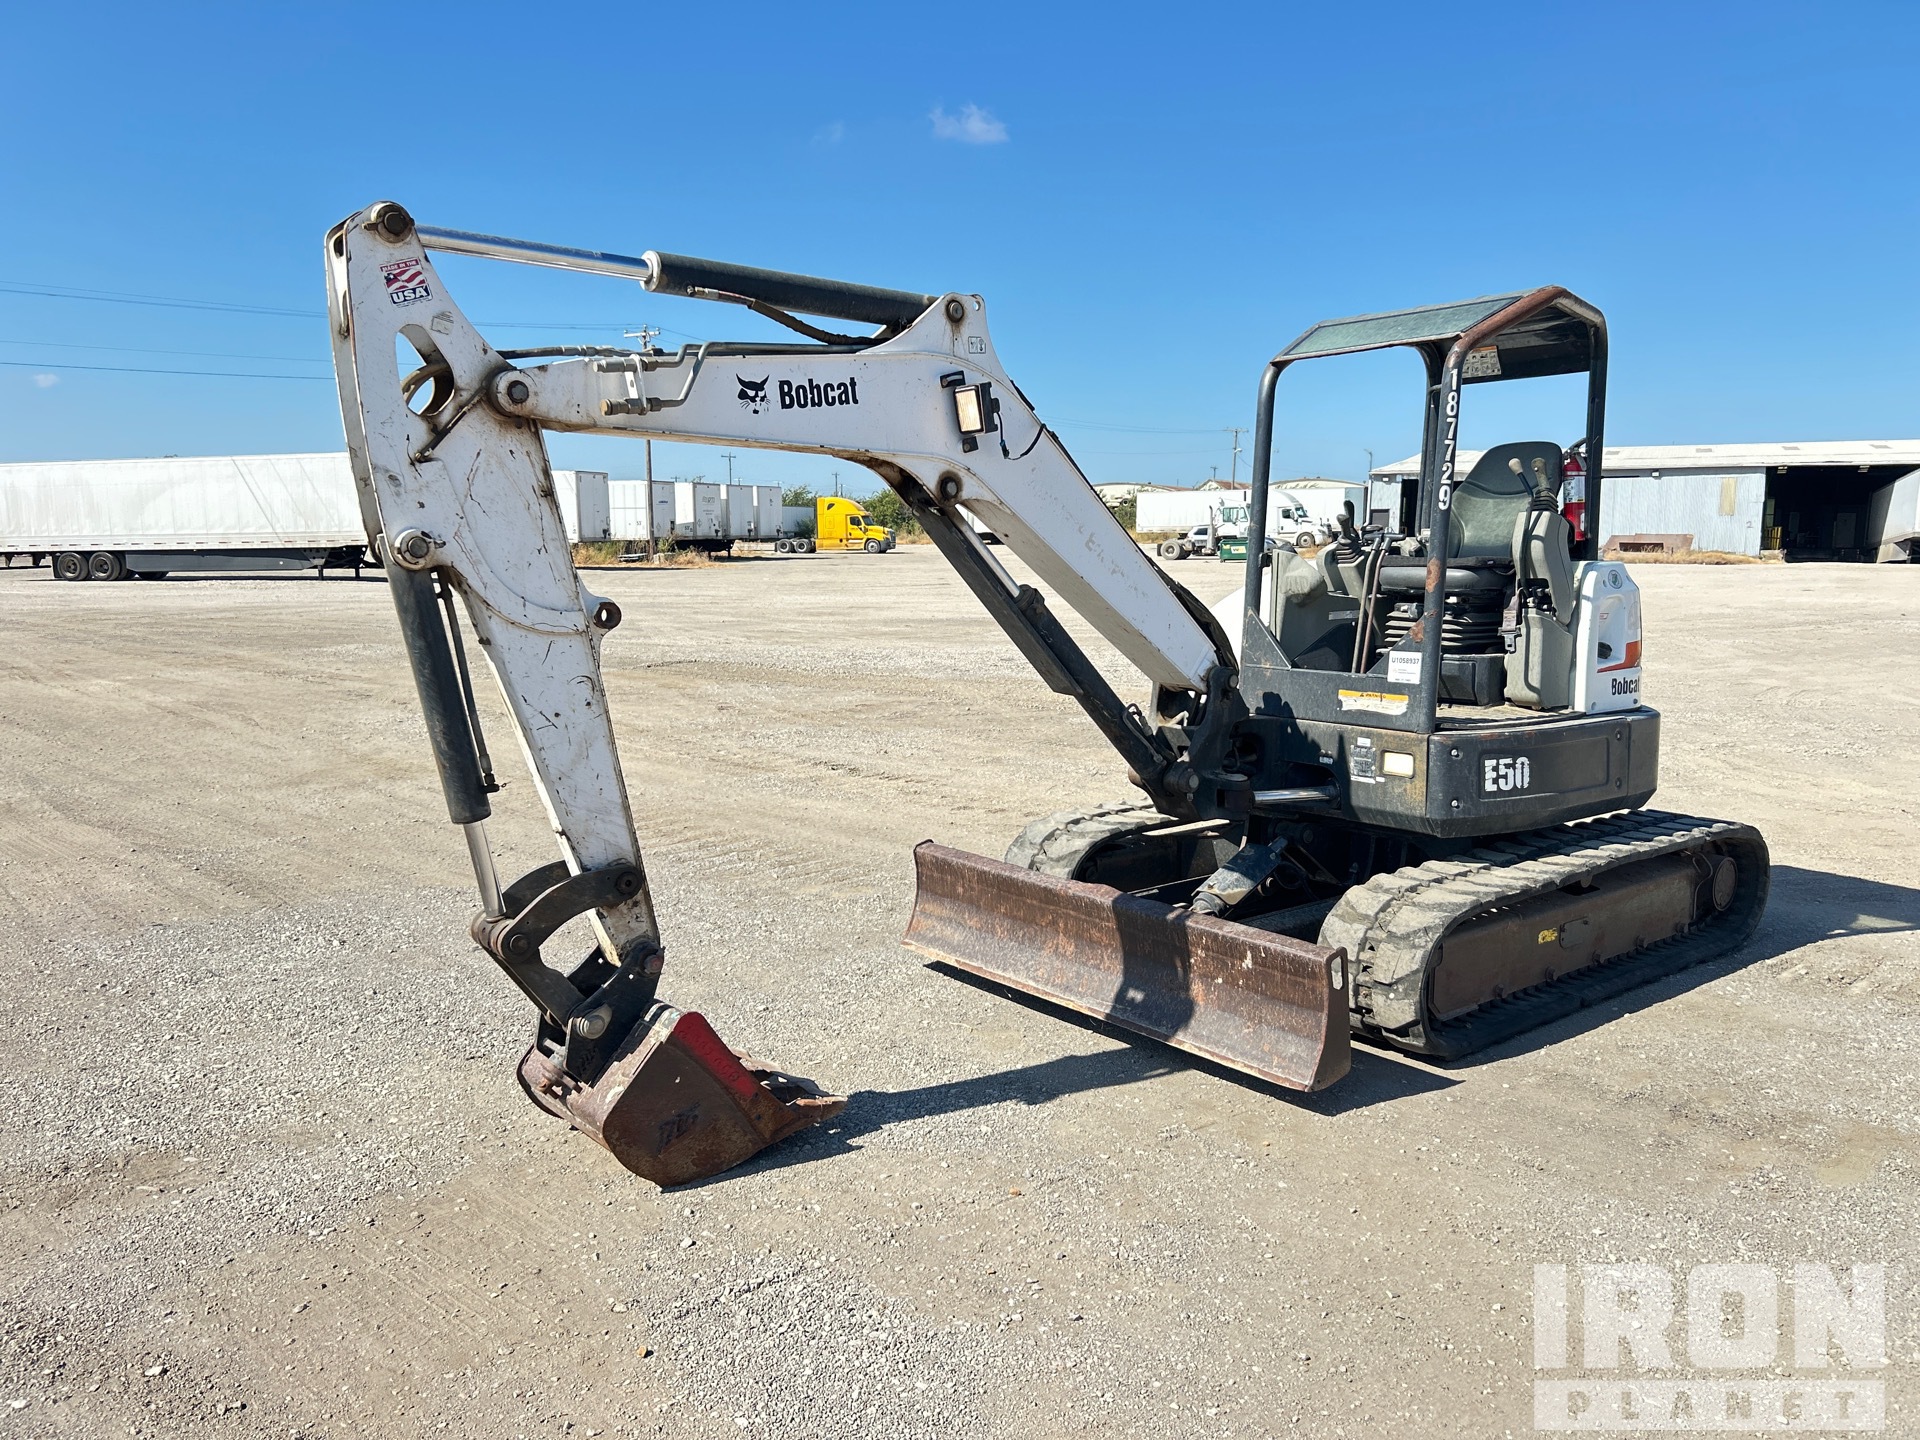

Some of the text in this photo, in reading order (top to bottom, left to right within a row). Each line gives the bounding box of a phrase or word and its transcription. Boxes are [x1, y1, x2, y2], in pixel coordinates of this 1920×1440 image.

[392, 288, 427, 303] USA
[778, 377, 859, 409] Bobcat
[1438, 368, 1458, 511] 187729
[1484, 756, 1530, 792] E50
